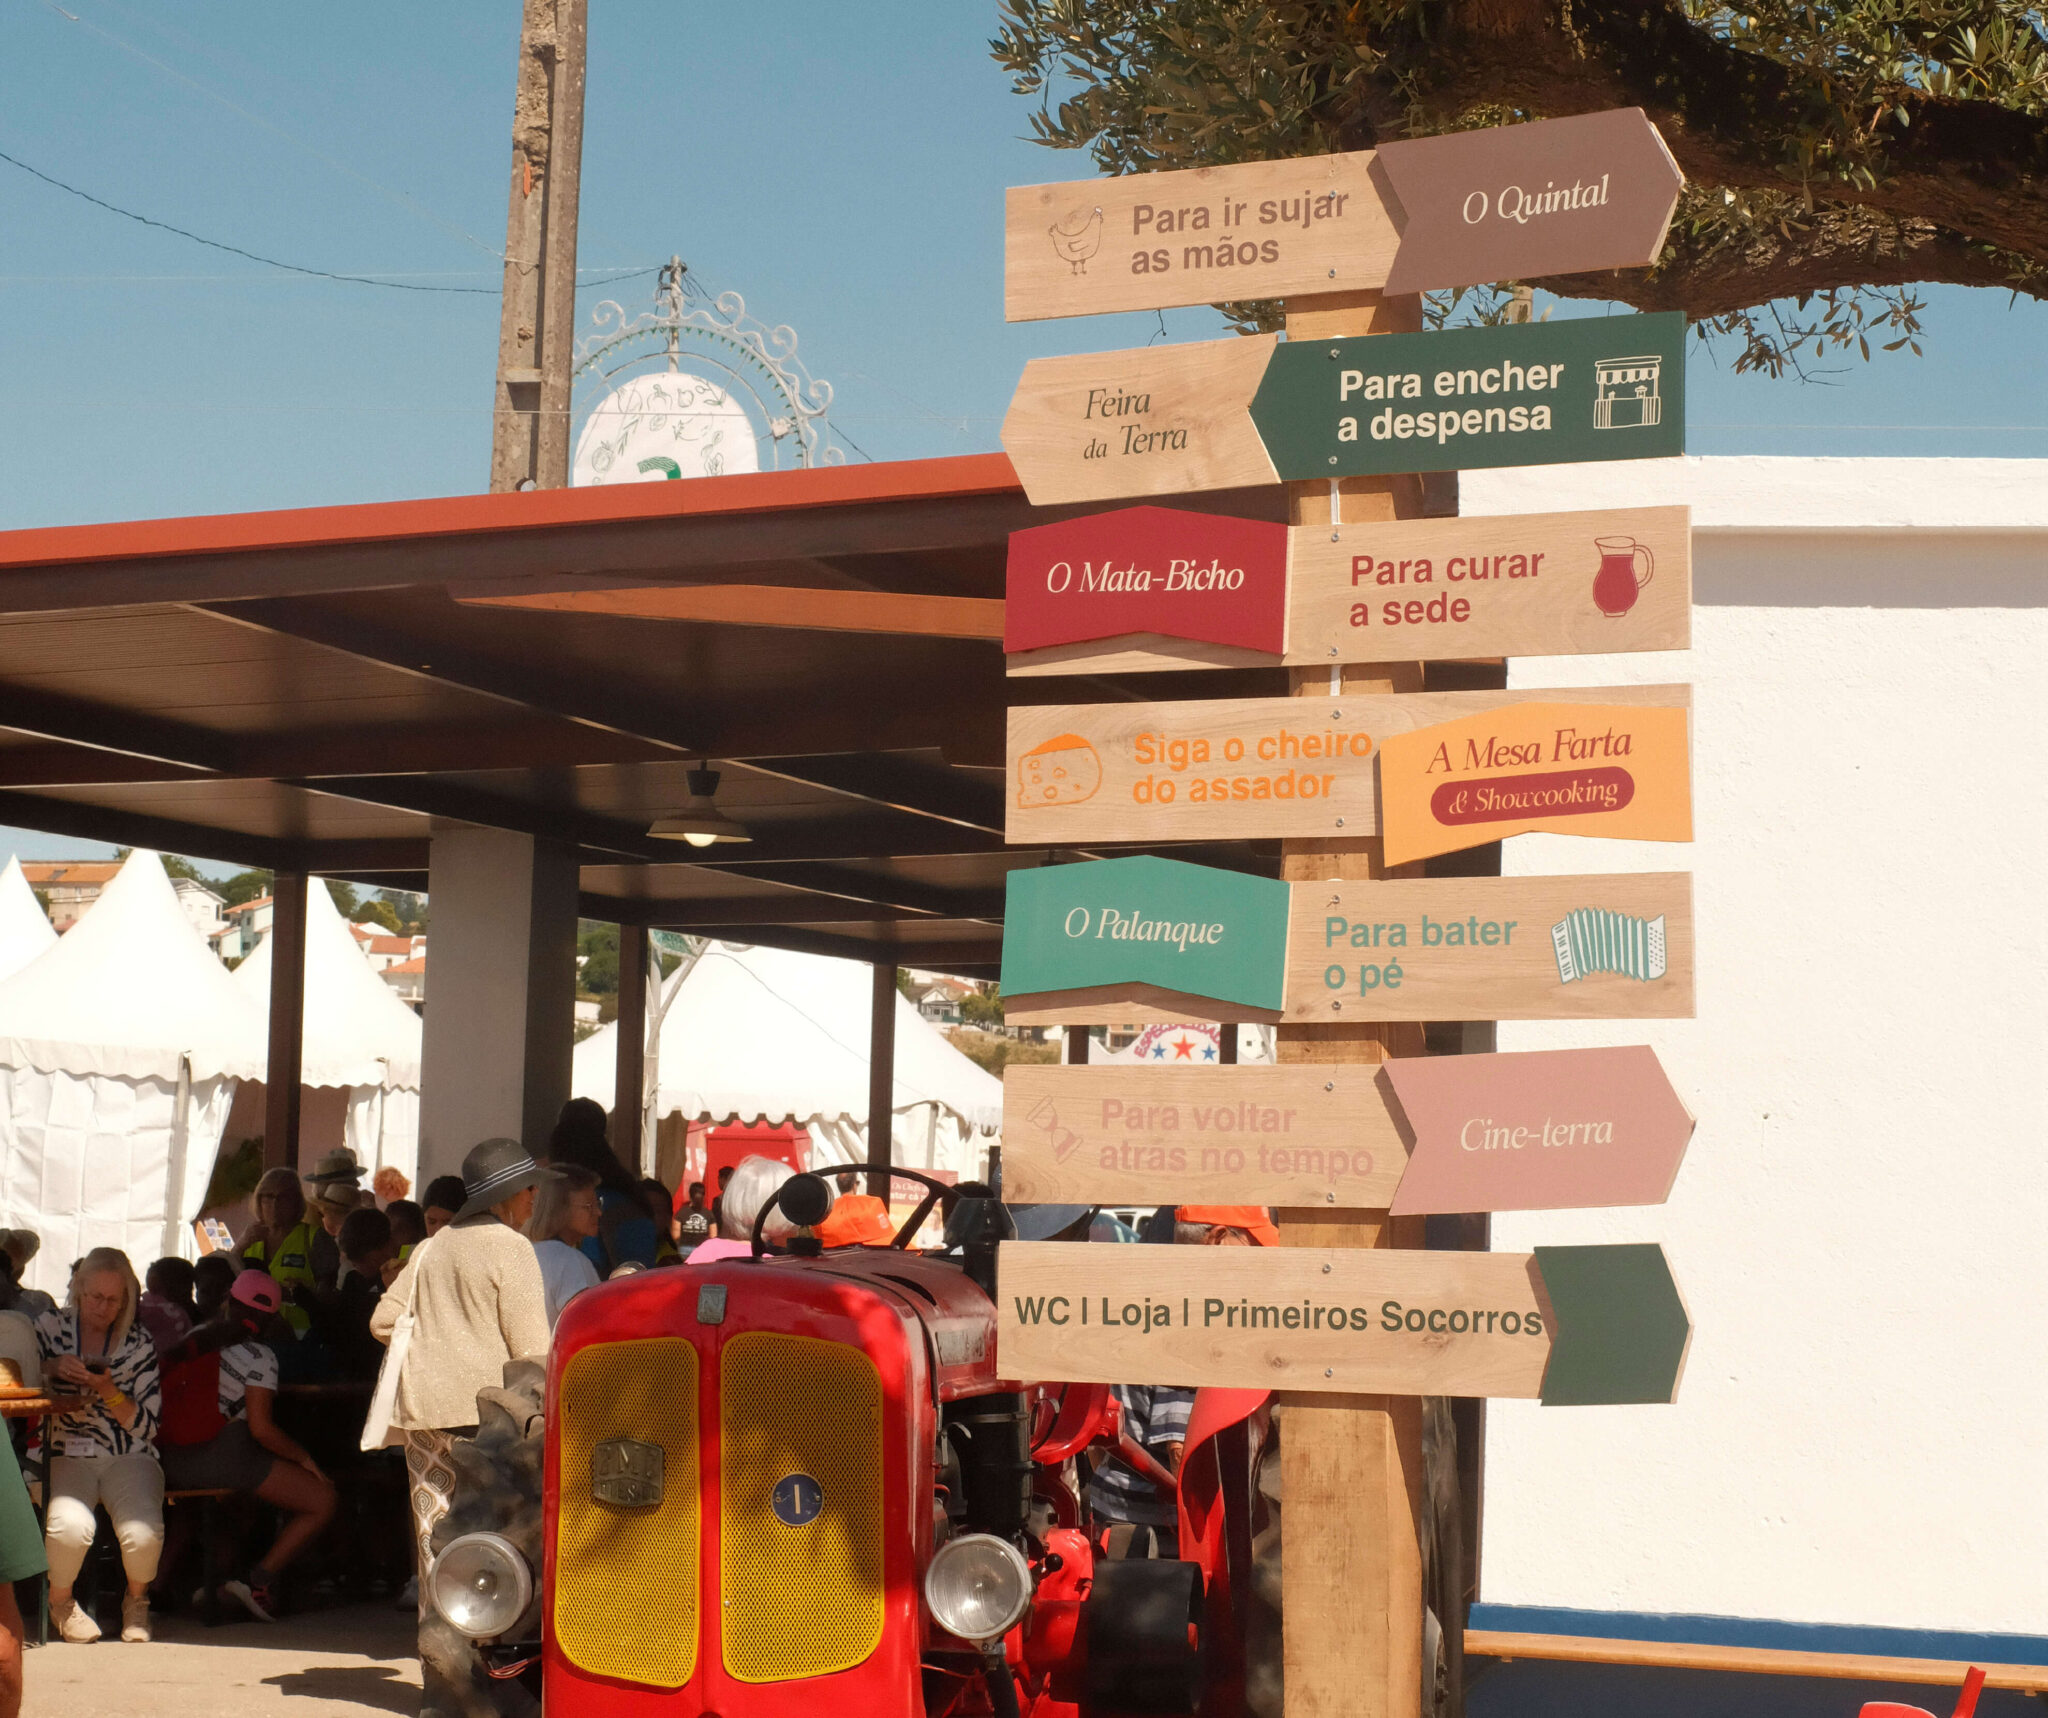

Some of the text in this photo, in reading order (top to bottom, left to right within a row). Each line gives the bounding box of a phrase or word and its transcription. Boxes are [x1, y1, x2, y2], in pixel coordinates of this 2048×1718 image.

[1134, 190, 1349, 235] Para ir sujar
[1463, 174, 1609, 224] O Quintal
[1132, 236, 1279, 274] as mãos
[1341, 360, 1564, 401] Para encher
[1085, 389, 1150, 419] Feira
[1083, 424, 1187, 459] da Terra
[1338, 405, 1551, 444] a despensa
[1047, 559, 1244, 593] O Mata-Bicho
[1352, 553, 1544, 586] Para curar
[1350, 592, 1470, 627] a sede
[1134, 730, 1373, 770] Siga o cheiro
[1426, 728, 1631, 773] A Mesa Farta
[1133, 769, 1335, 803] do assador
[1474, 777, 1618, 812] Showcooking
[1065, 907, 1224, 952] O Palanque
[1326, 915, 1517, 947] Para bater
[1324, 957, 1403, 997] o pé
[1102, 1099, 1296, 1132] Para voltar
[1461, 1118, 1612, 1151] Cine-terra
[1099, 1138, 1373, 1180] atrás no tempo
[1015, 1297, 1069, 1325] WC
[1102, 1298, 1170, 1334] Loja
[1205, 1299, 1368, 1331] Primeiros
[1381, 1302, 1542, 1335] Socorros
